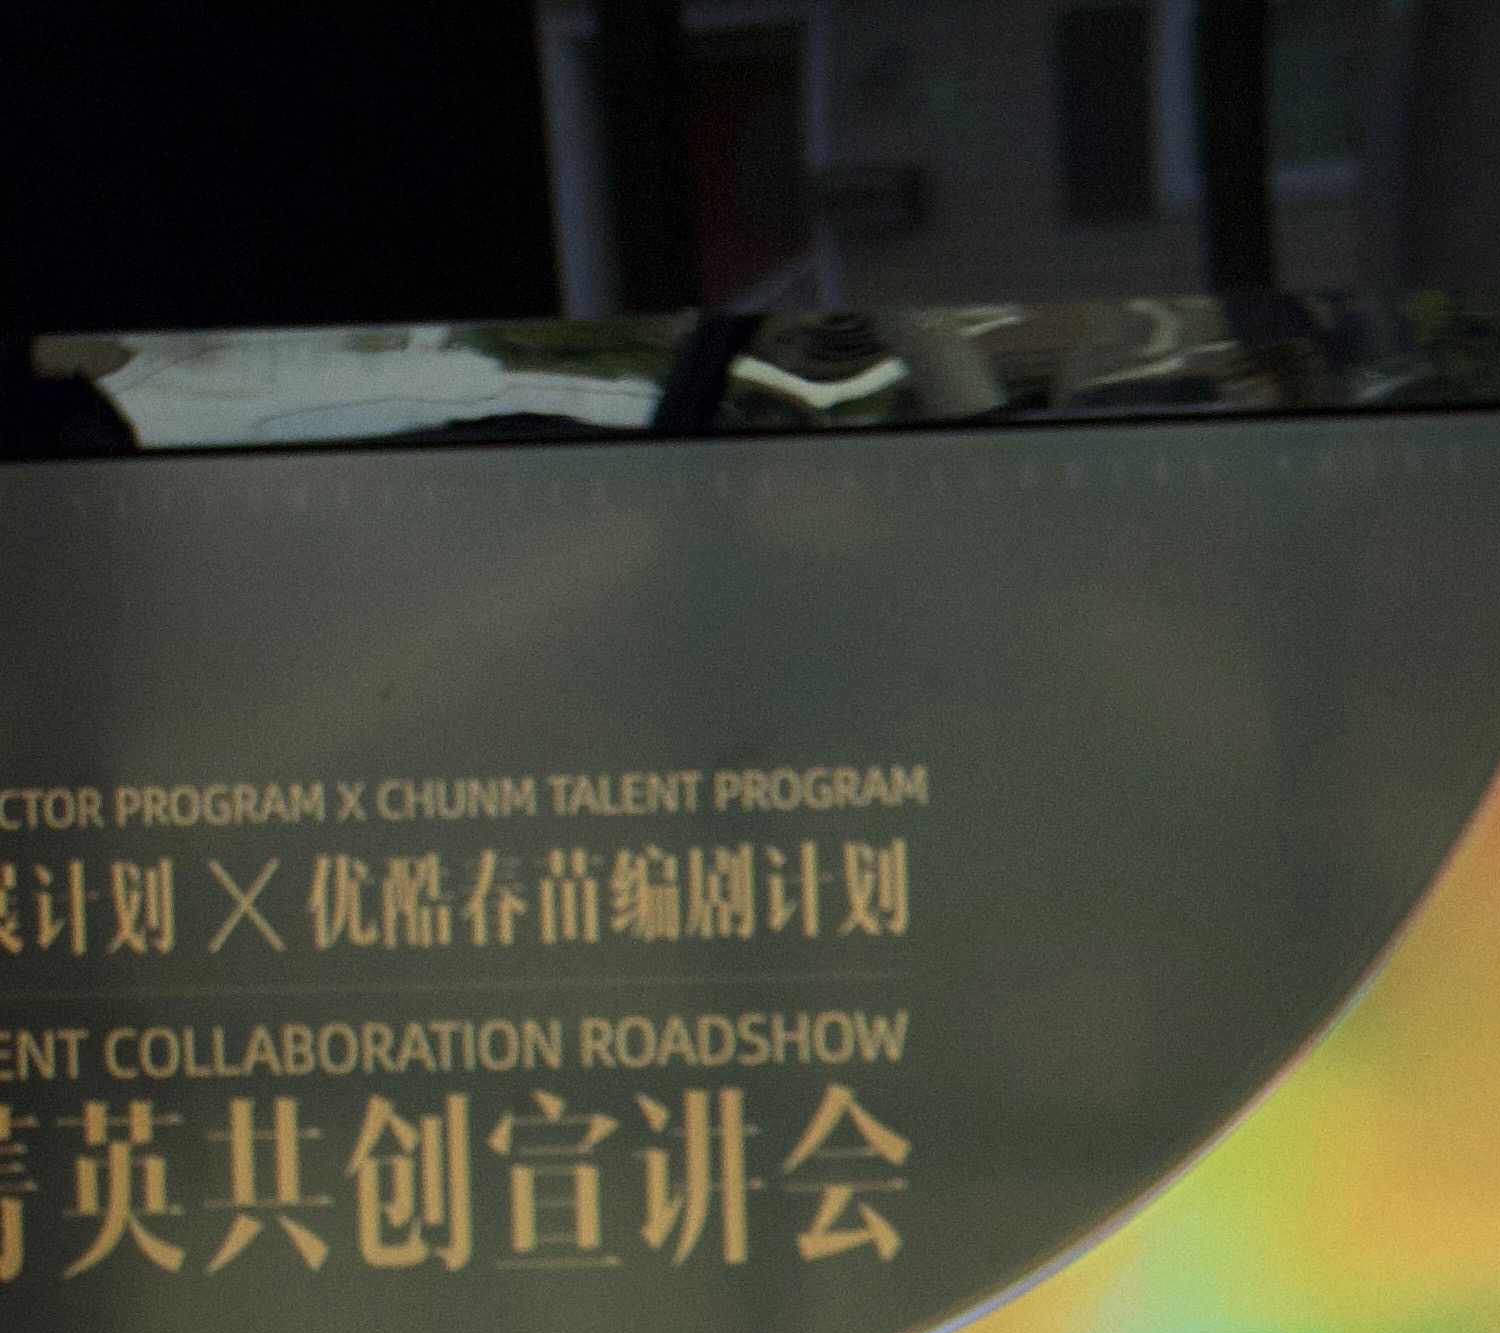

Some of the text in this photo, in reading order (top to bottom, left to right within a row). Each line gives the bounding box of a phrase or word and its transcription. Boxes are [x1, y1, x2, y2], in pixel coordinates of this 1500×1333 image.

[116, 780, 327, 826] PROGRAM
[336, 781, 367, 821] X
[376, 776, 537, 821] CHUNM
[546, 771, 702, 816] TALENT
[714, 764, 930, 811] PROGRAM
[309, 841, 910, 948] 优酷春苗编剧计划
[106, 1015, 565, 1078] COLLABORATION
[579, 1010, 909, 1068] ROADSHOW
